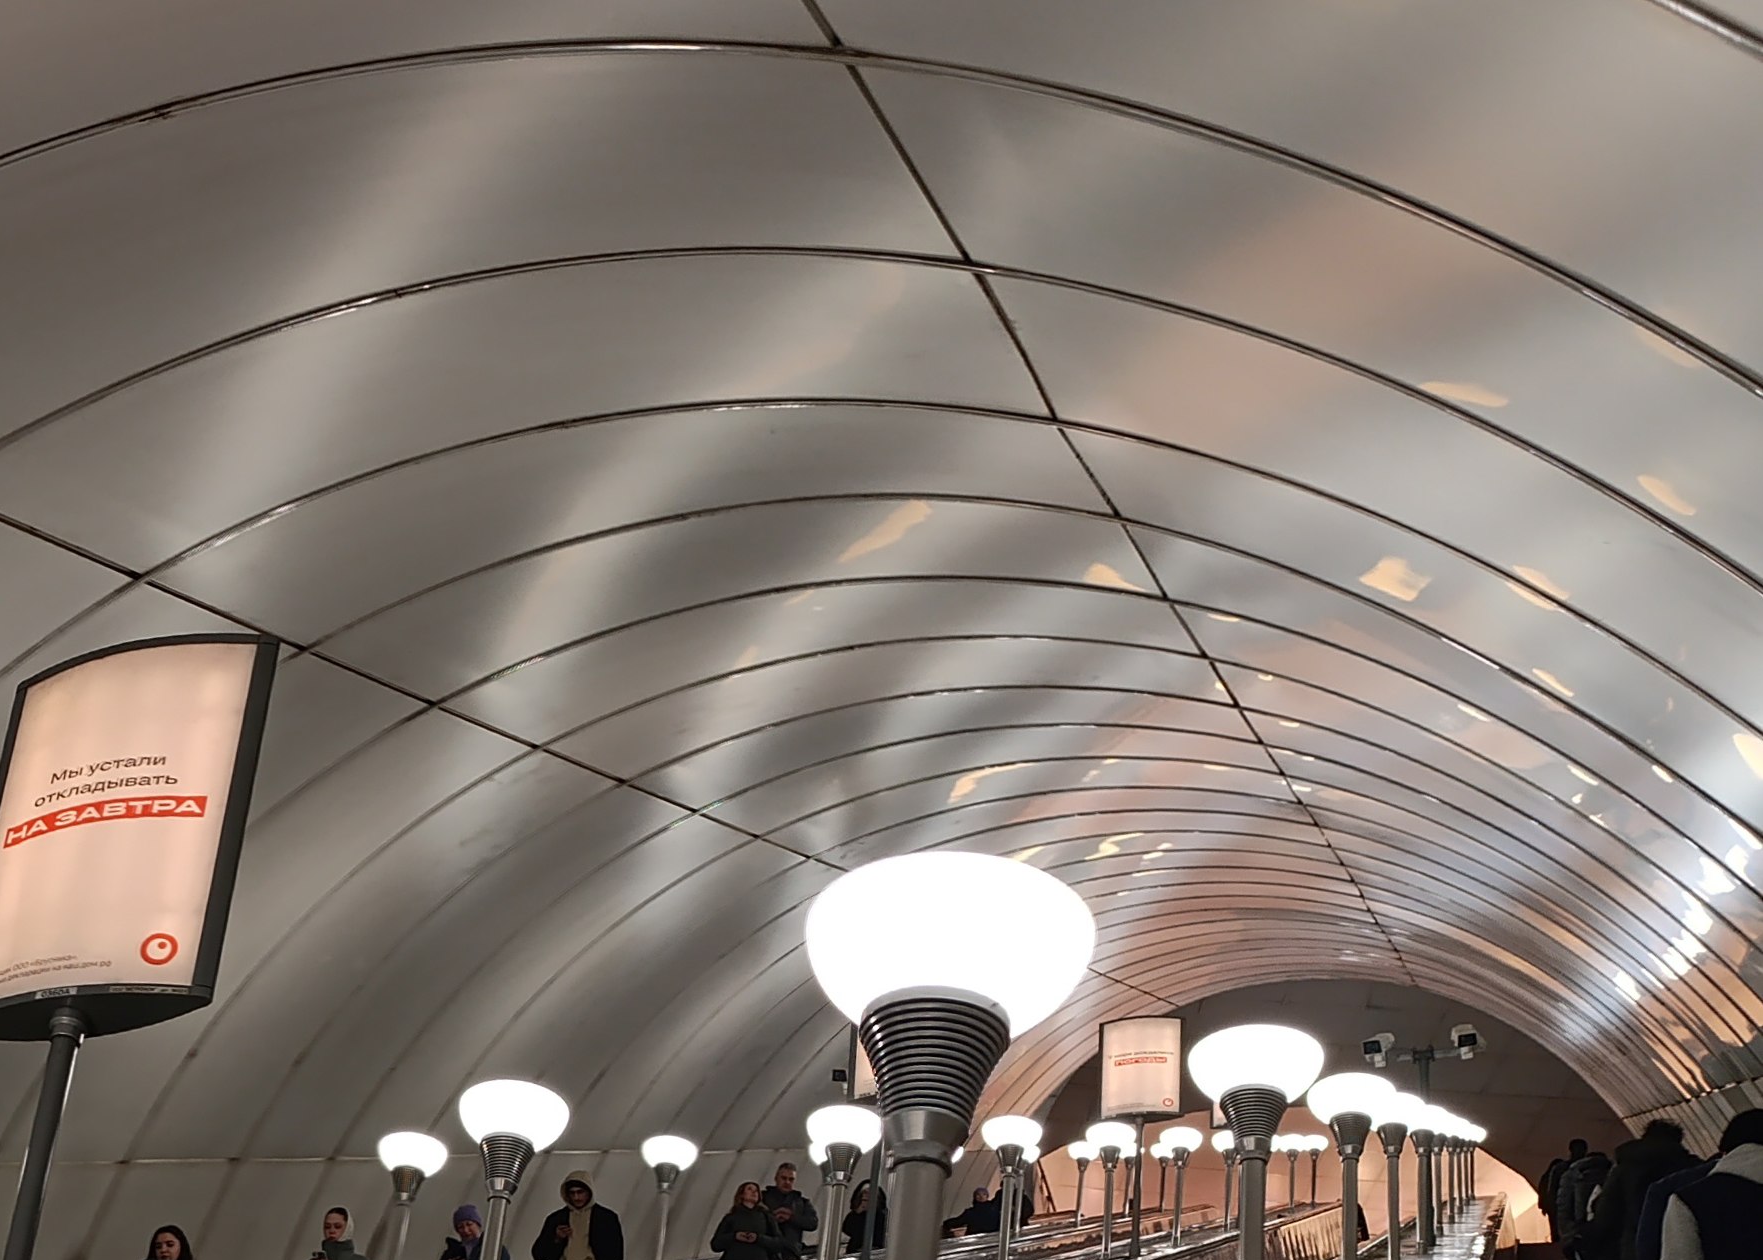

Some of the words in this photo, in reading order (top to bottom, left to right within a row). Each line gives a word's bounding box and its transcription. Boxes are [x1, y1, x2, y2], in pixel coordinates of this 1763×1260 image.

[50, 768, 82, 784] Мы
[86, 756, 166, 776] устали
[34, 775, 178, 807] откладывать
[6, 820, 48, 845] НА
[54, 799, 202, 827] ЗАВТРА
